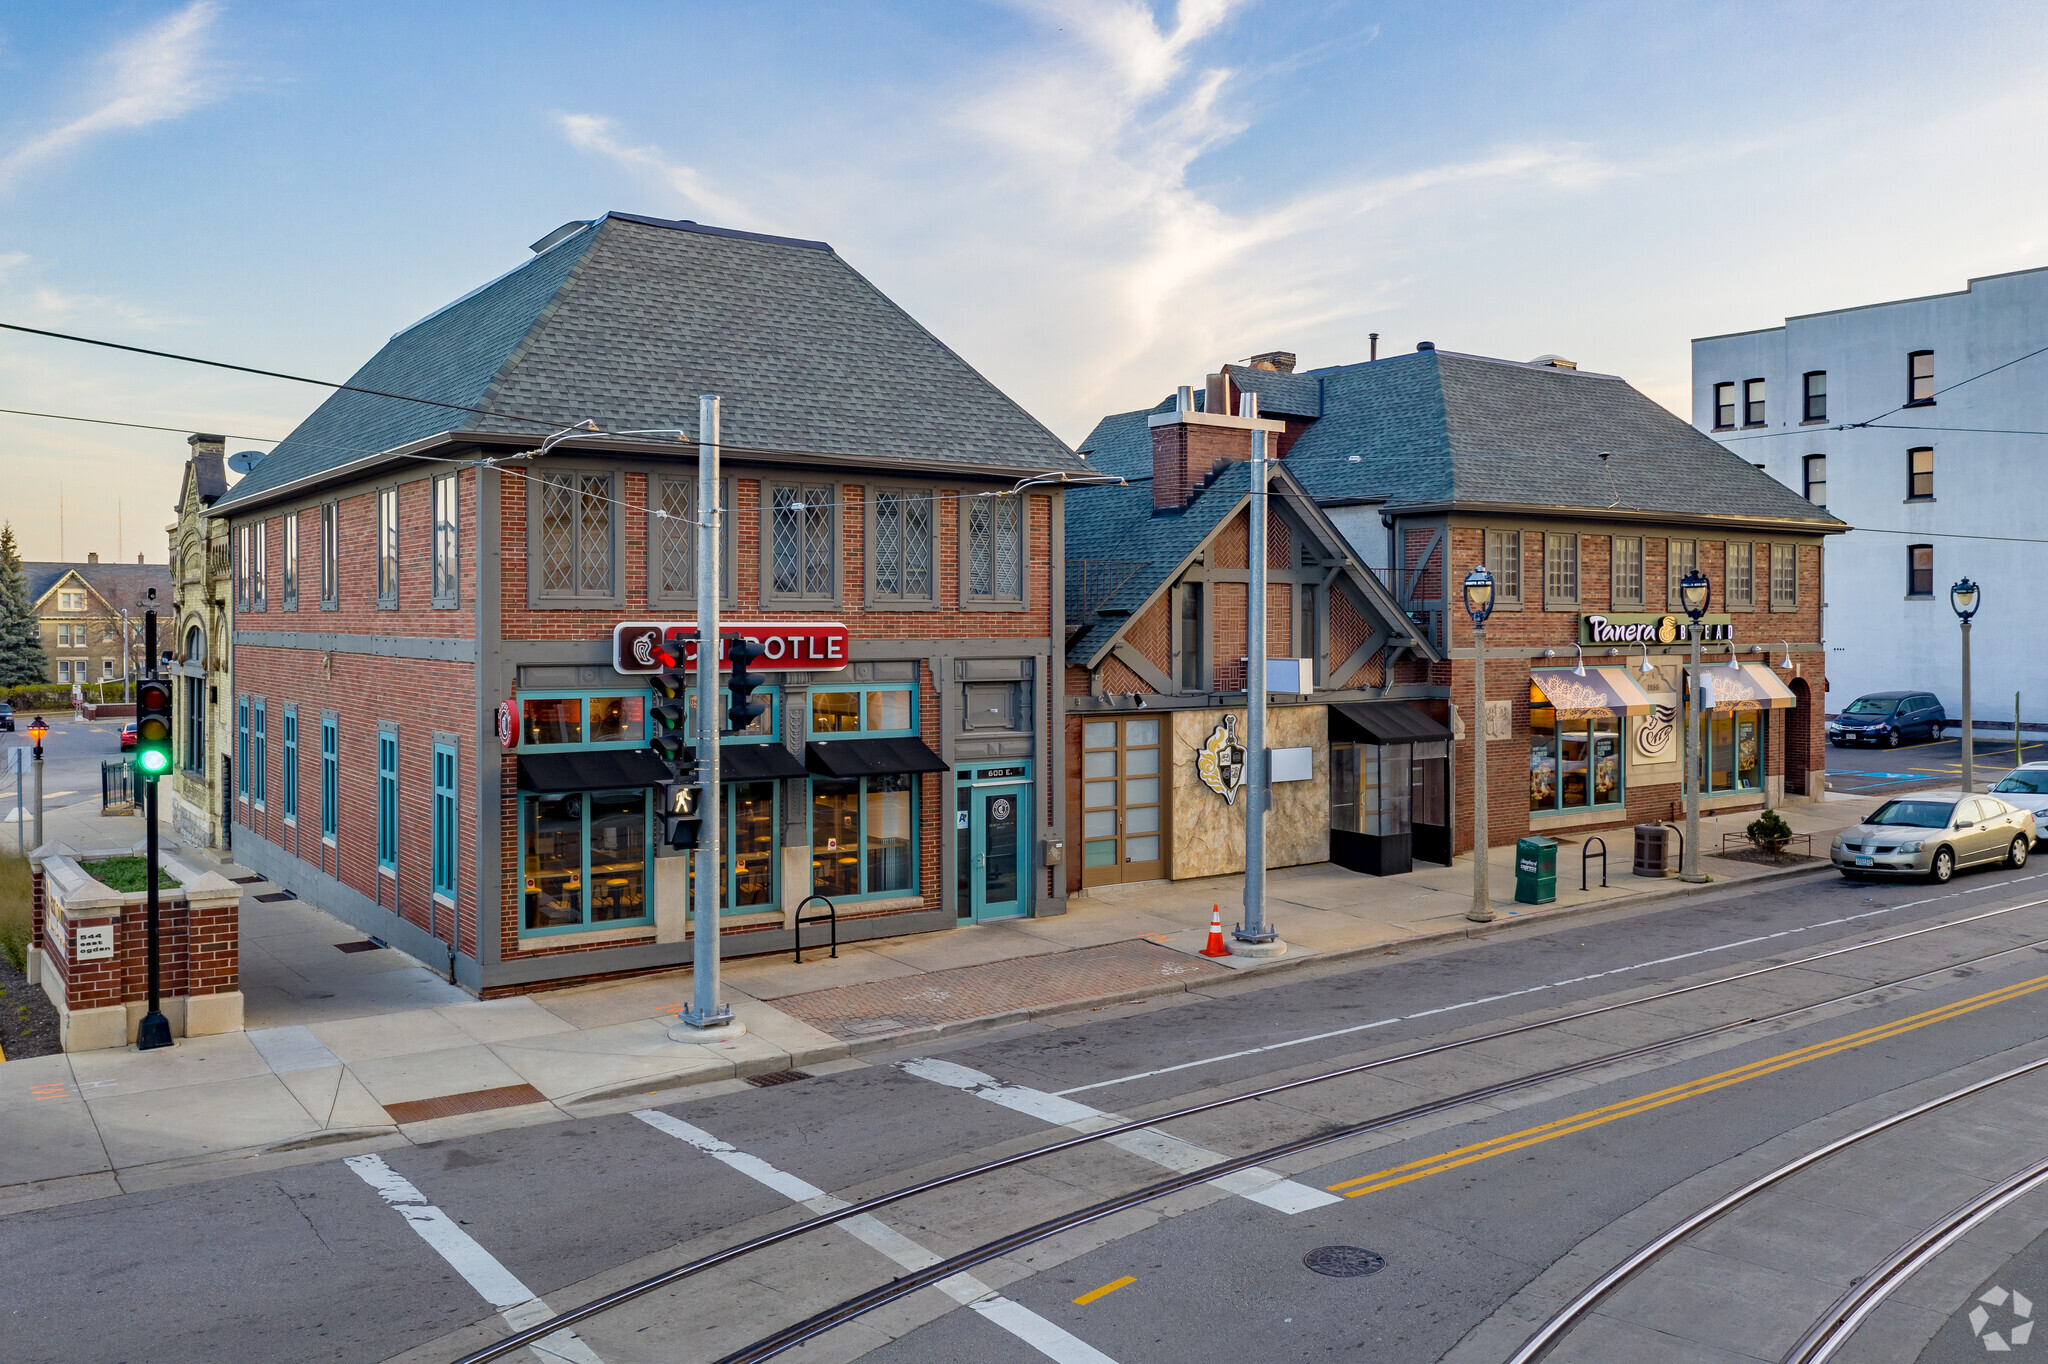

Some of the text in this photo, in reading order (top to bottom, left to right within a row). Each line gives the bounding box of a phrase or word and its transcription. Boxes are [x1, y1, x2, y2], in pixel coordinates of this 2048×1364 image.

[1589, 615, 1733, 642] Panera BEAD
[988, 768, 1013, 777] 600 E.
[80, 946, 111, 954] ogden
